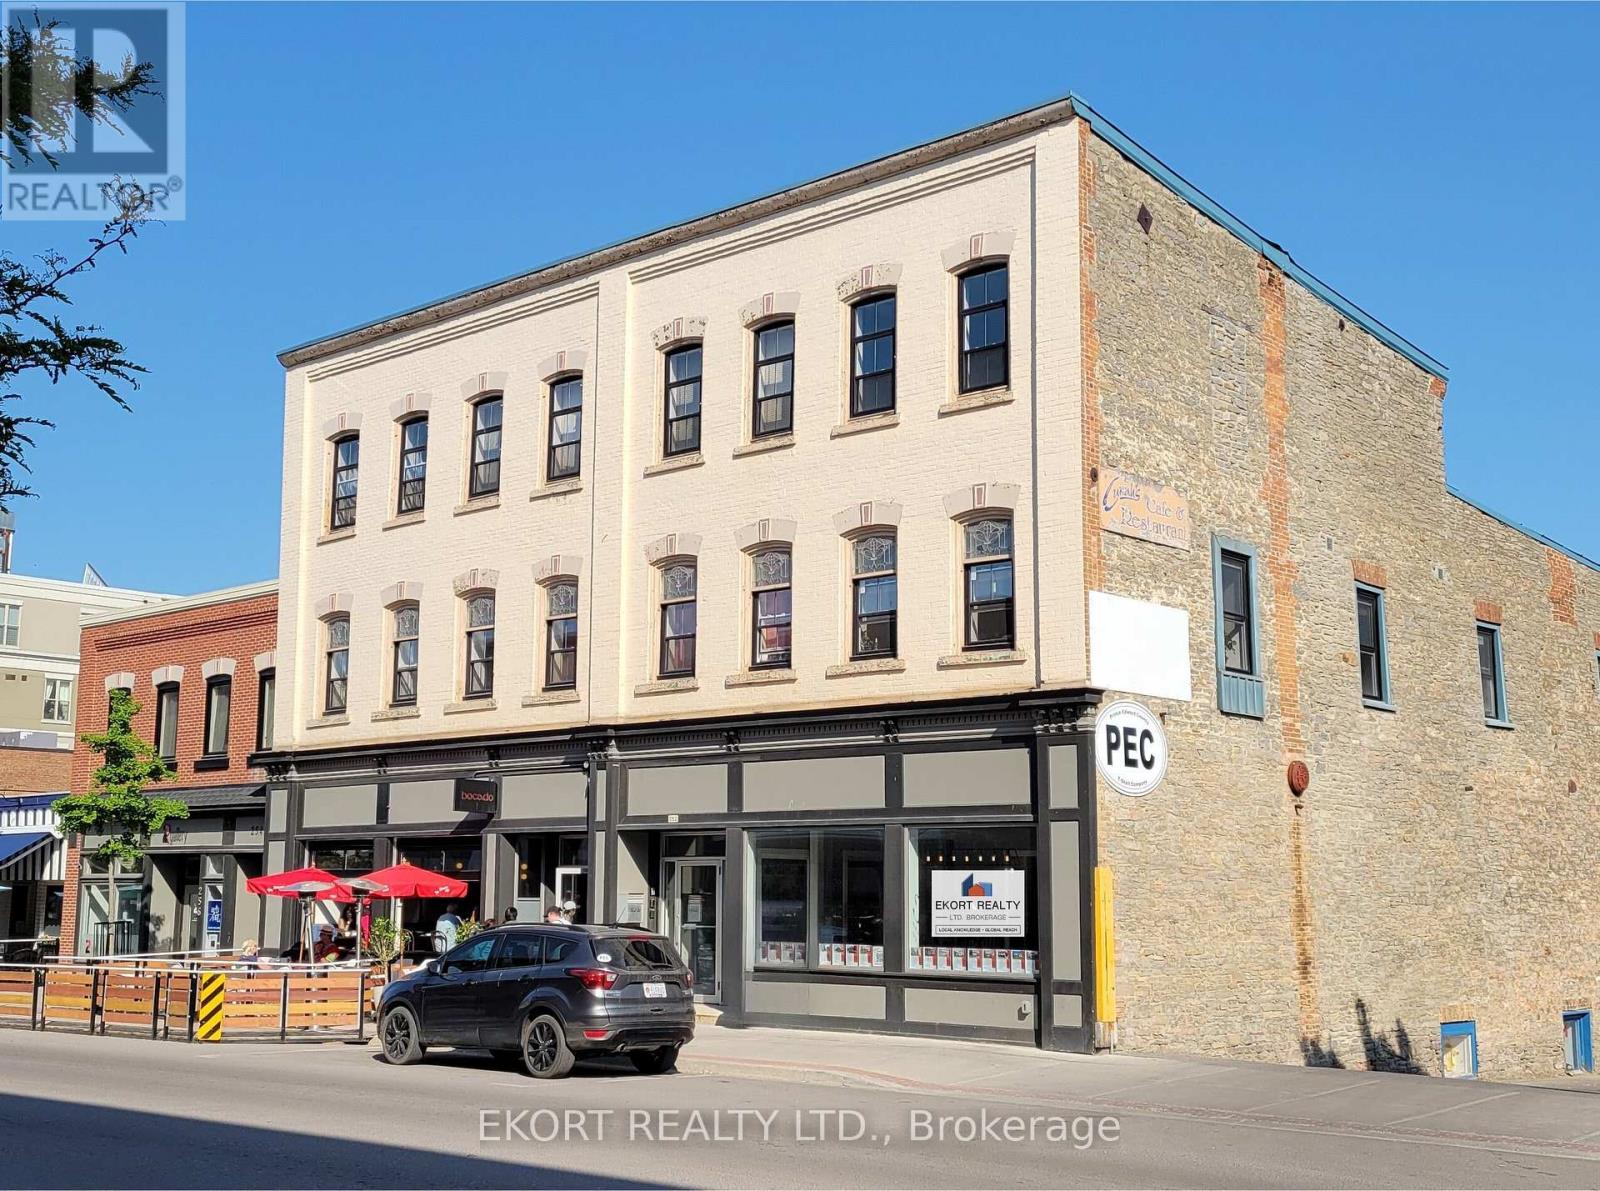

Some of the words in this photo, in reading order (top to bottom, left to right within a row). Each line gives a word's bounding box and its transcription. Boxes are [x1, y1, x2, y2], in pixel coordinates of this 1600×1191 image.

[1105, 724, 1156, 771] PEC
[461, 791, 494, 802] bocado
[935, 900, 973, 910] EKORT
[977, 900, 1020, 910] REALTY
